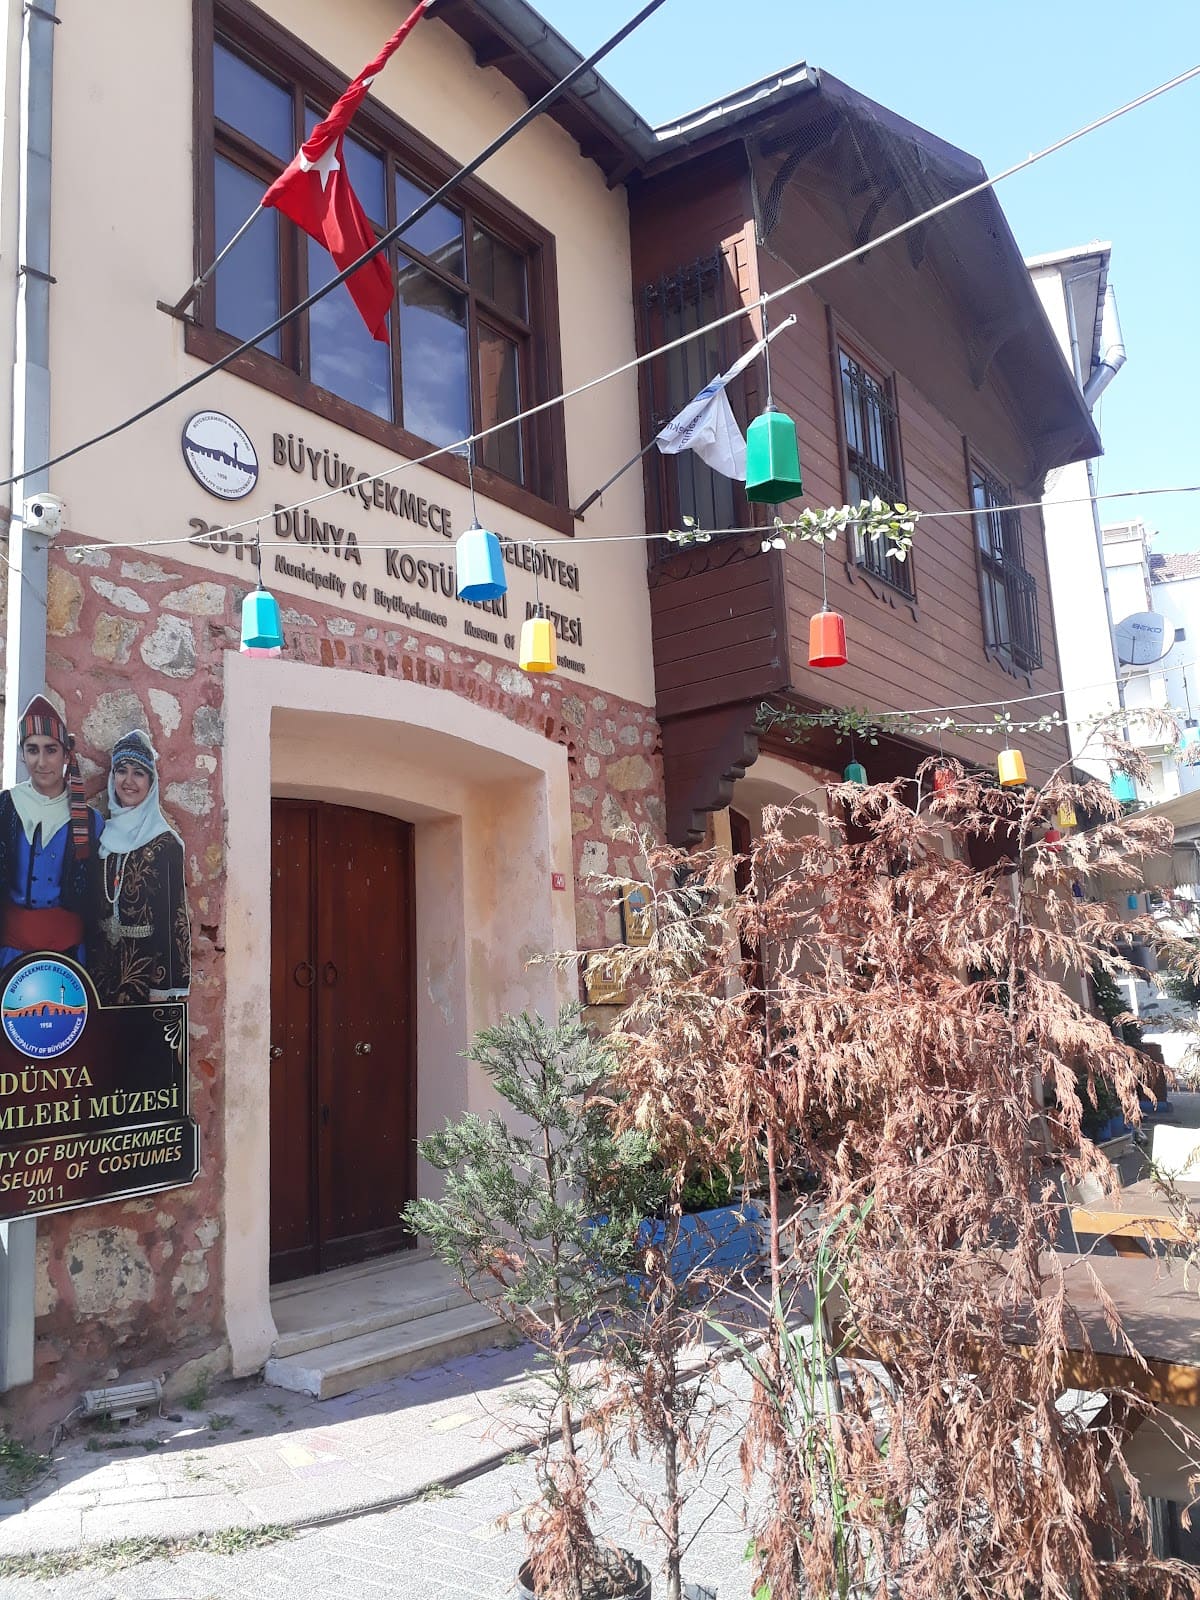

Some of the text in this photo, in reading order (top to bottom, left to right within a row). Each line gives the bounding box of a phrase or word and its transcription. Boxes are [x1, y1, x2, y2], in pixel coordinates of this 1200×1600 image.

[273, 432, 453, 538] BÜYÜKÇEKMECE
[189, 517, 261, 565] 2011
[274, 503, 362, 565] DÜNYA
[274, 554, 586, 674] Municipality Of Büyükçekmece Museum Of ostumes
[7, 1020, 40, 1054] MUNICIPALITY
[0, 1064, 94, 1096] DÜNYA
[88, 1082, 180, 1119] MÜZESİ
[25, 1146, 50, 1166] OF
[53, 1126, 184, 1161] BUYUKCEKMECE
[66, 1161, 90, 1180] OF
[98, 1145, 183, 1174] COSTUMES
[27, 1185, 64, 1205] 2011
